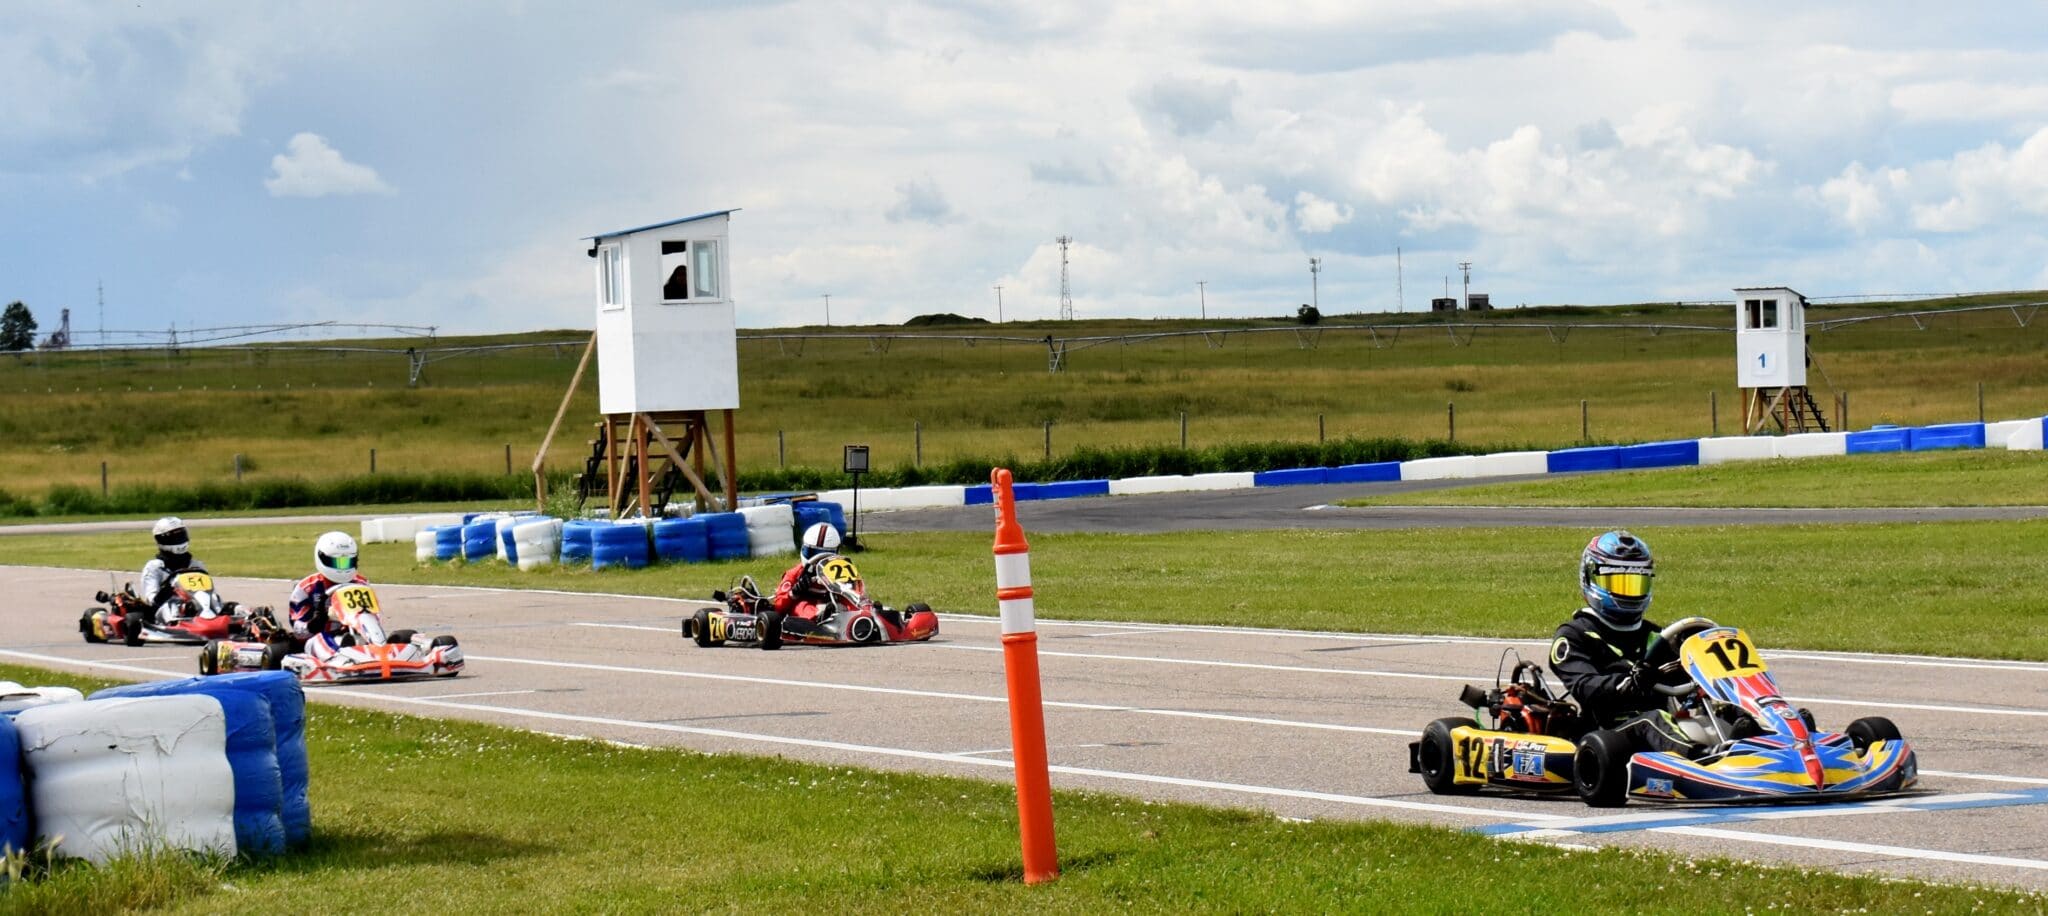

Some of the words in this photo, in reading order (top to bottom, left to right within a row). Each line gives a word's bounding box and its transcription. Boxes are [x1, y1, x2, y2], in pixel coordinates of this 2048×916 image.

[1757, 352, 1766, 369] 1
[829, 563, 857, 580] 21
[187, 576, 204, 588] 51
[343, 588, 374, 609] 331
[1704, 638, 1760, 672] 12
[1458, 735, 1487, 779] 12
